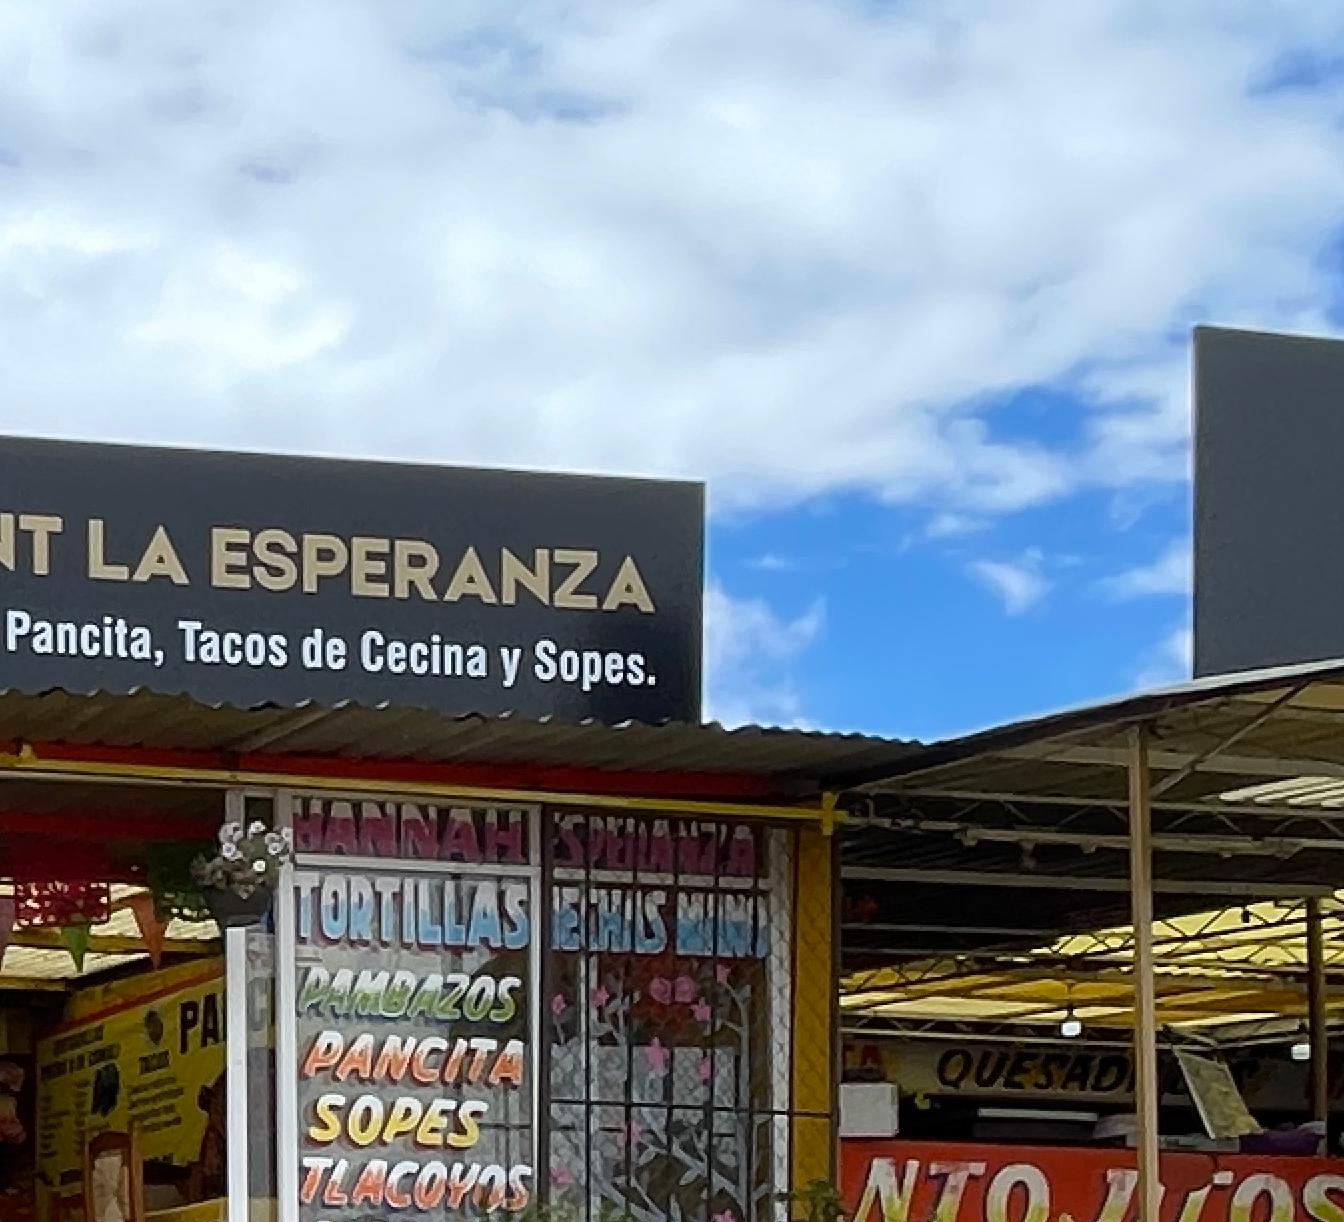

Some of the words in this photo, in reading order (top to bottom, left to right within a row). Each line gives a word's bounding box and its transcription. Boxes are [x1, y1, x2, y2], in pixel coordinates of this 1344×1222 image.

[87, 519, 190, 585] LA
[211, 528, 655, 614] ESPERANZA
[6, 609, 164, 668] Pancita,
[178, 621, 288, 669] Tacos
[300, 629, 348, 671] de
[360, 630, 488, 680] Cecina
[500, 648, 521, 688] y
[533, 641, 658, 692] Sopes.
[293, 799, 521, 865] HANNAH
[292, 872, 529, 950] TORTILLAS
[296, 966, 522, 1022] PAMBAZOS
[303, 1031, 525, 1086] PANCITA
[307, 1095, 489, 1149] SOPES
[300, 1156, 534, 1214] TLACOYOS
